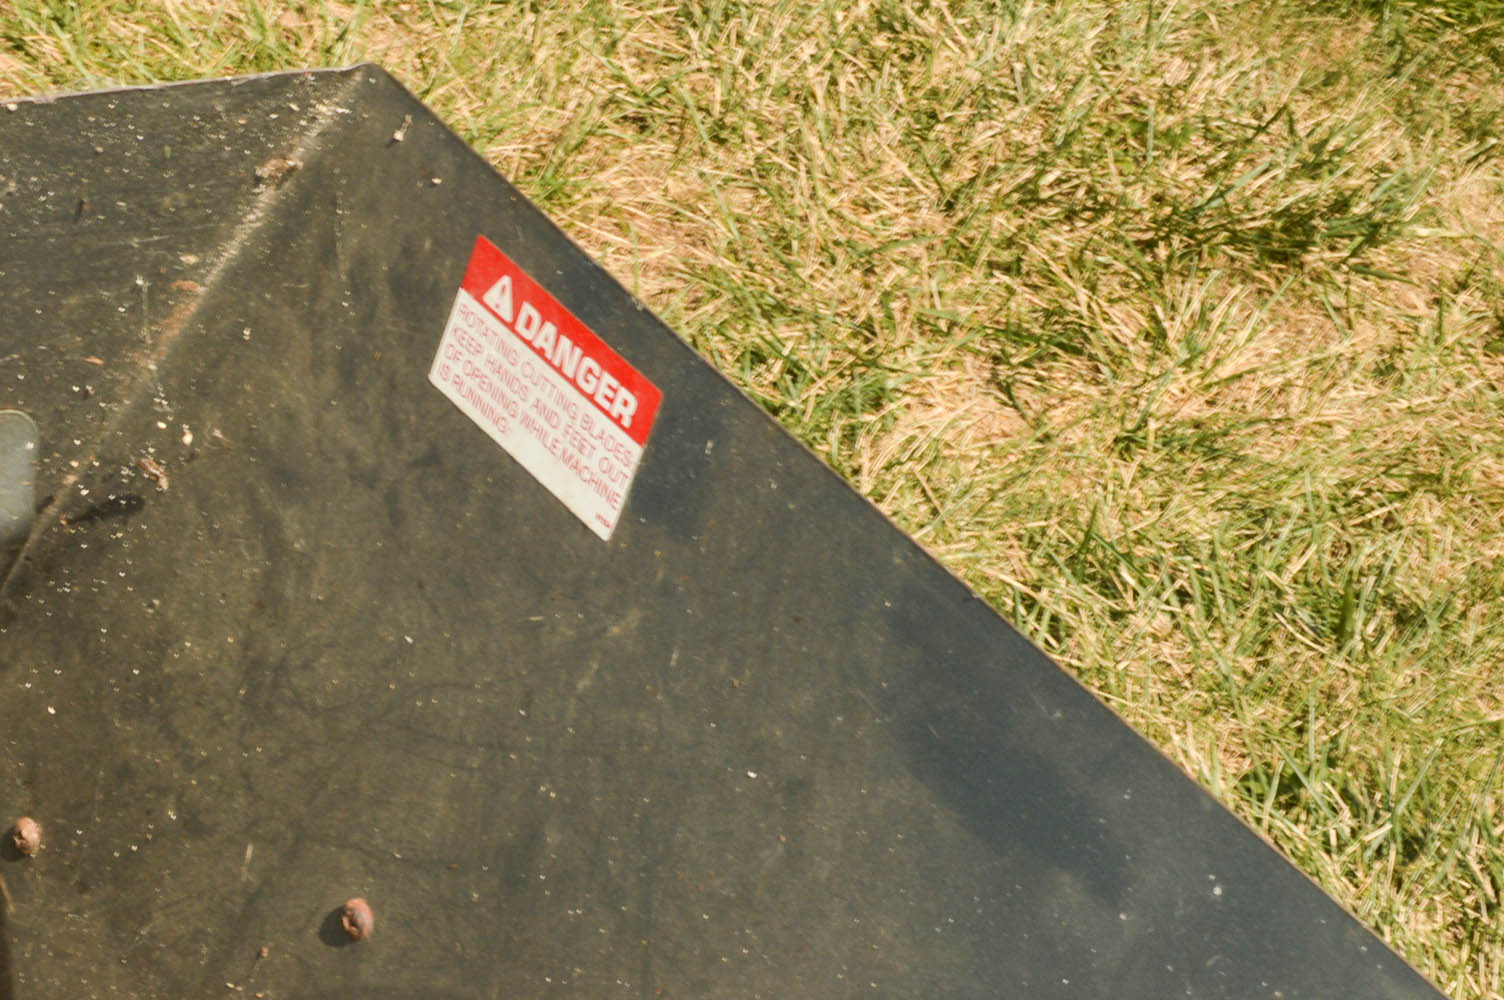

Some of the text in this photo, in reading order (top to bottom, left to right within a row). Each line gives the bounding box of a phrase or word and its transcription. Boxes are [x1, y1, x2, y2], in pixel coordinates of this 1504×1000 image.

[437, 360, 452, 383] IS
[444, 341, 621, 512] OF OPENING WHILE MACHINE
[450, 321, 628, 492] KEEP HANDS AND FEET OUT
[456, 301, 521, 369] ROTATING
[518, 357, 579, 422] CUTTING
[513, 298, 639, 430] DANGER
